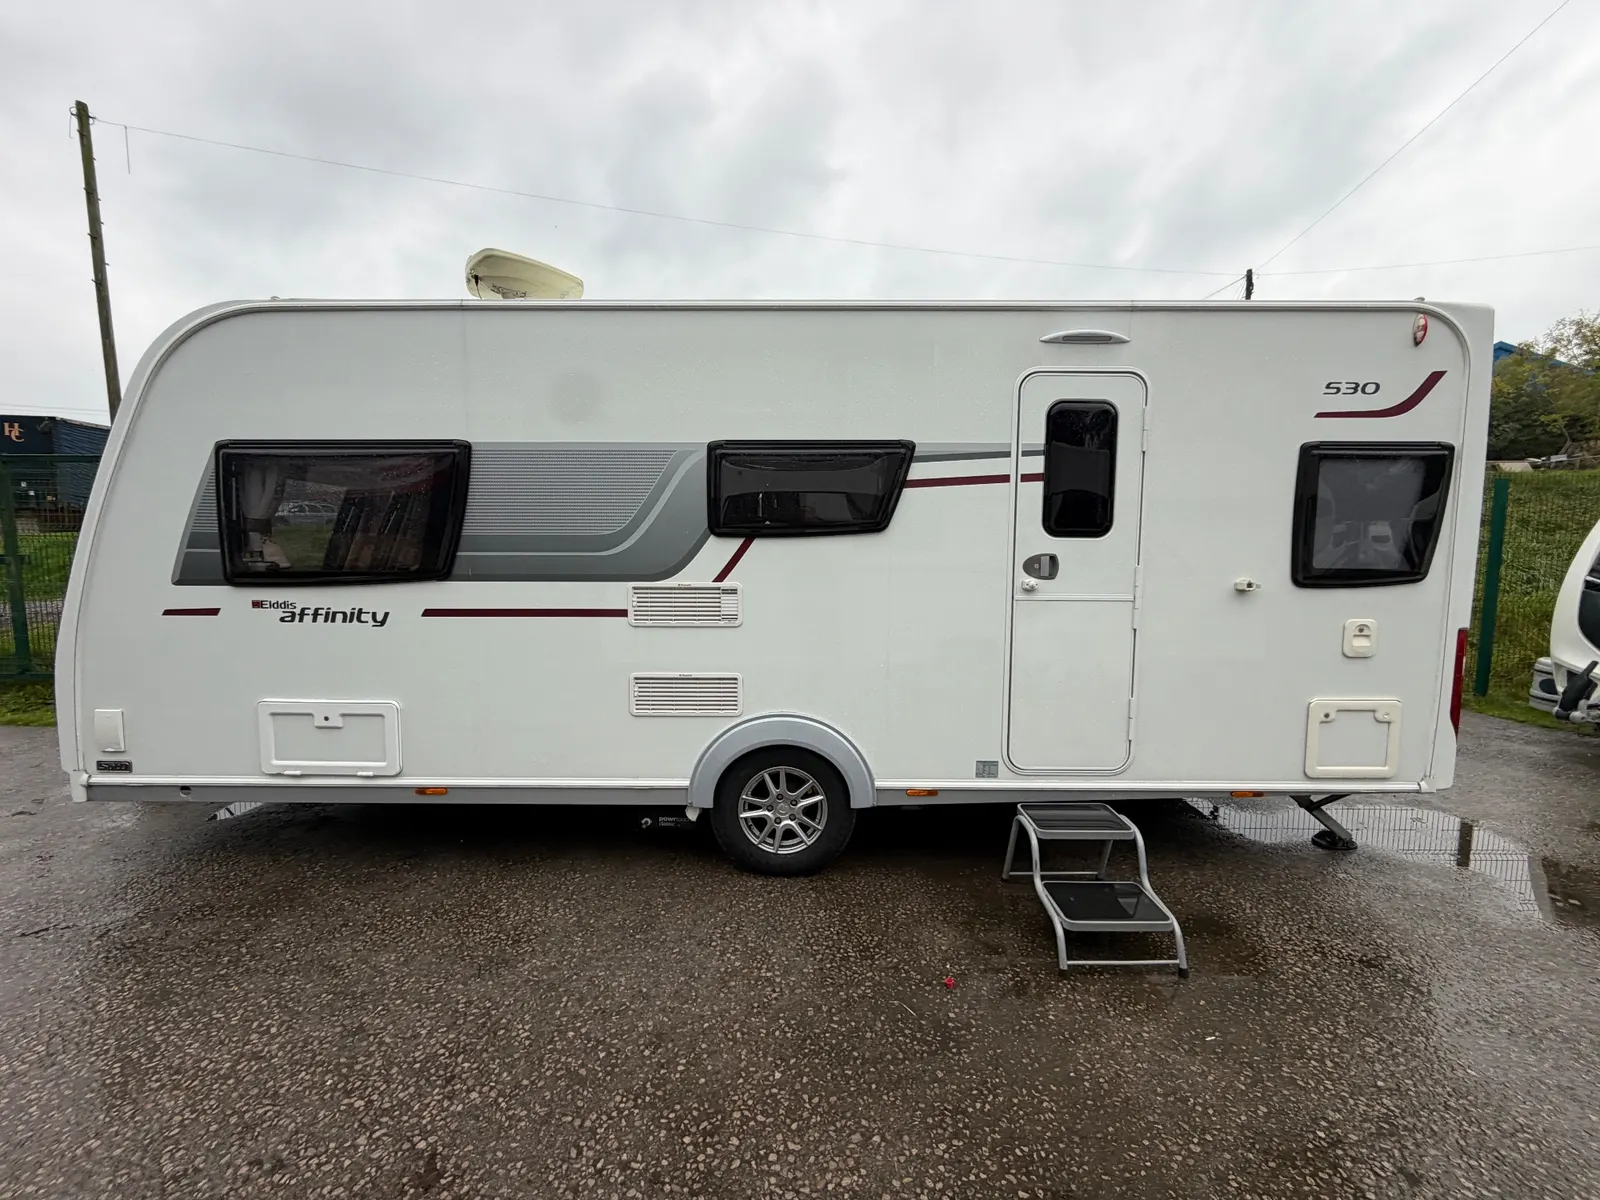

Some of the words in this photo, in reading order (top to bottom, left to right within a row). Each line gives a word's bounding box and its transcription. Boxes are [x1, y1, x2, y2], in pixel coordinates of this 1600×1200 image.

[1322, 381, 1381, 395] 530
[260, 600, 297, 610] Elddis
[279, 607, 390, 627] affinity
